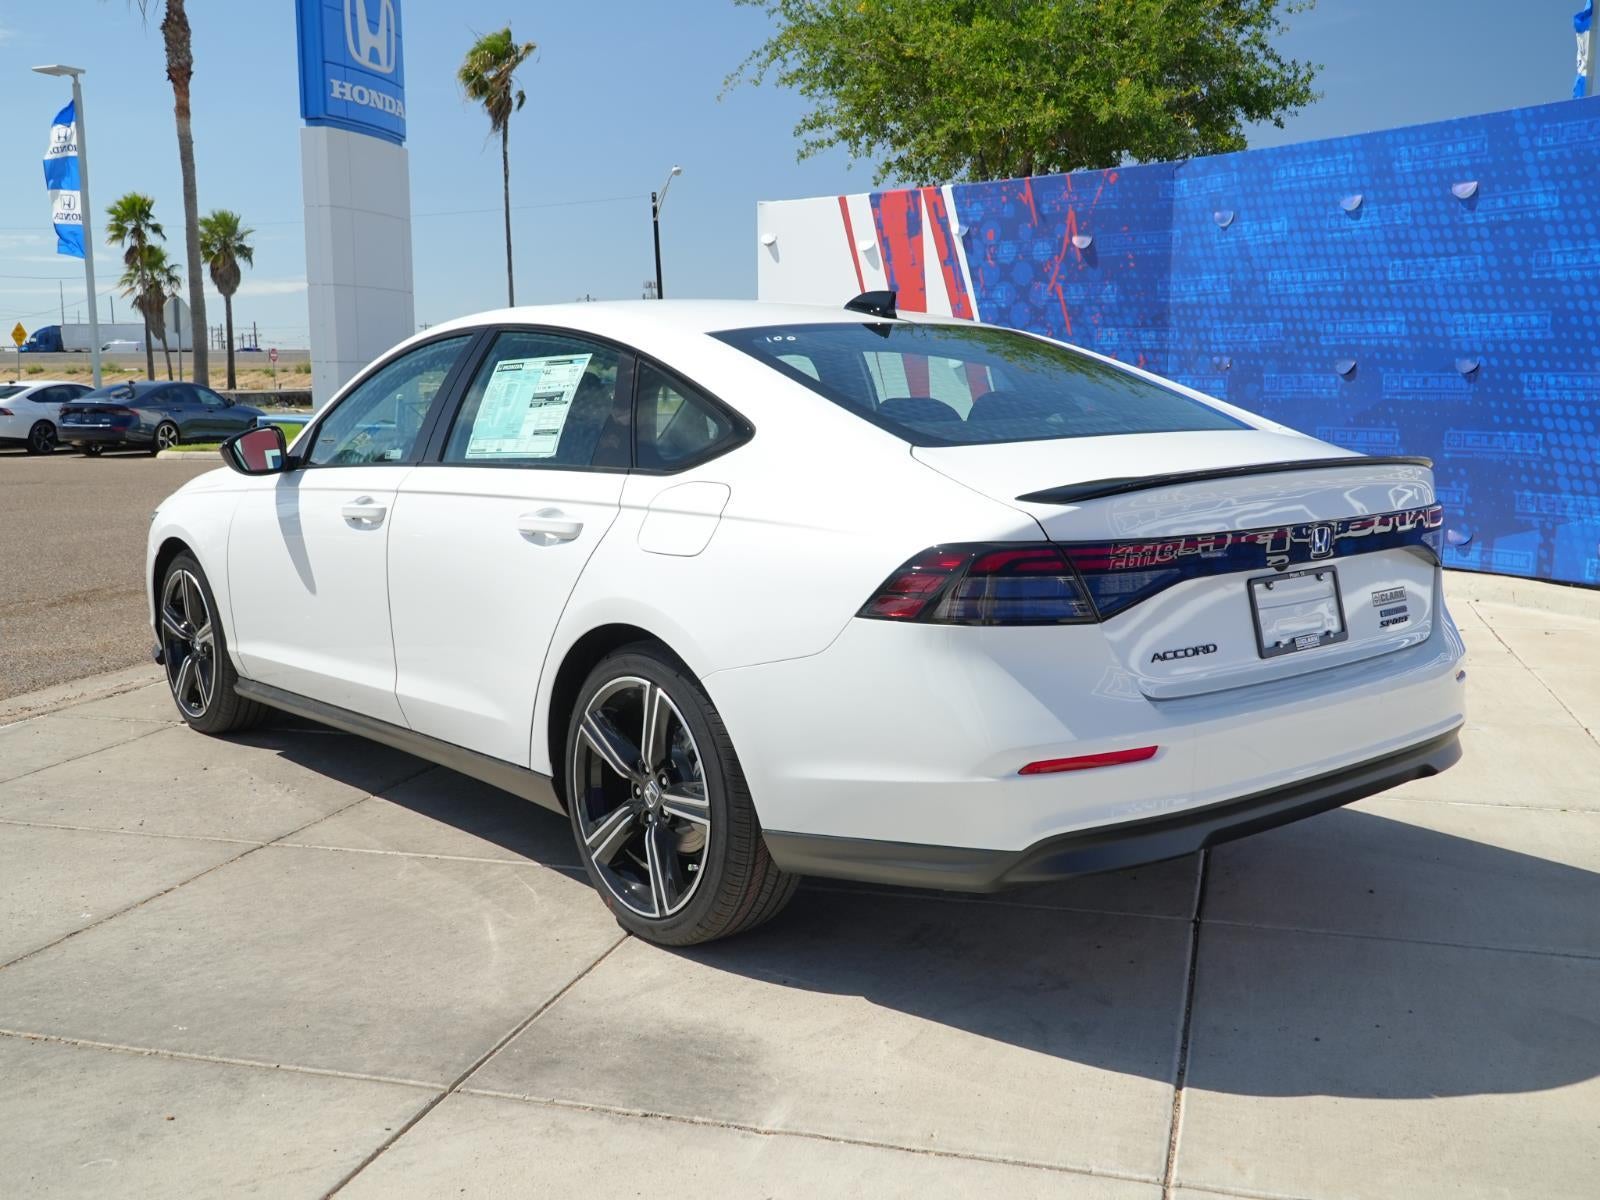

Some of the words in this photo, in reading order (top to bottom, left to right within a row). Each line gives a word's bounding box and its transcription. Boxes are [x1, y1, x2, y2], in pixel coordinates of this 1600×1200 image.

[330, 79, 405, 119] HONDA
[1465, 434, 1538, 449] CLARK
[1380, 589, 1405, 602] CLARK
[1151, 643, 1217, 663] ACCORD
